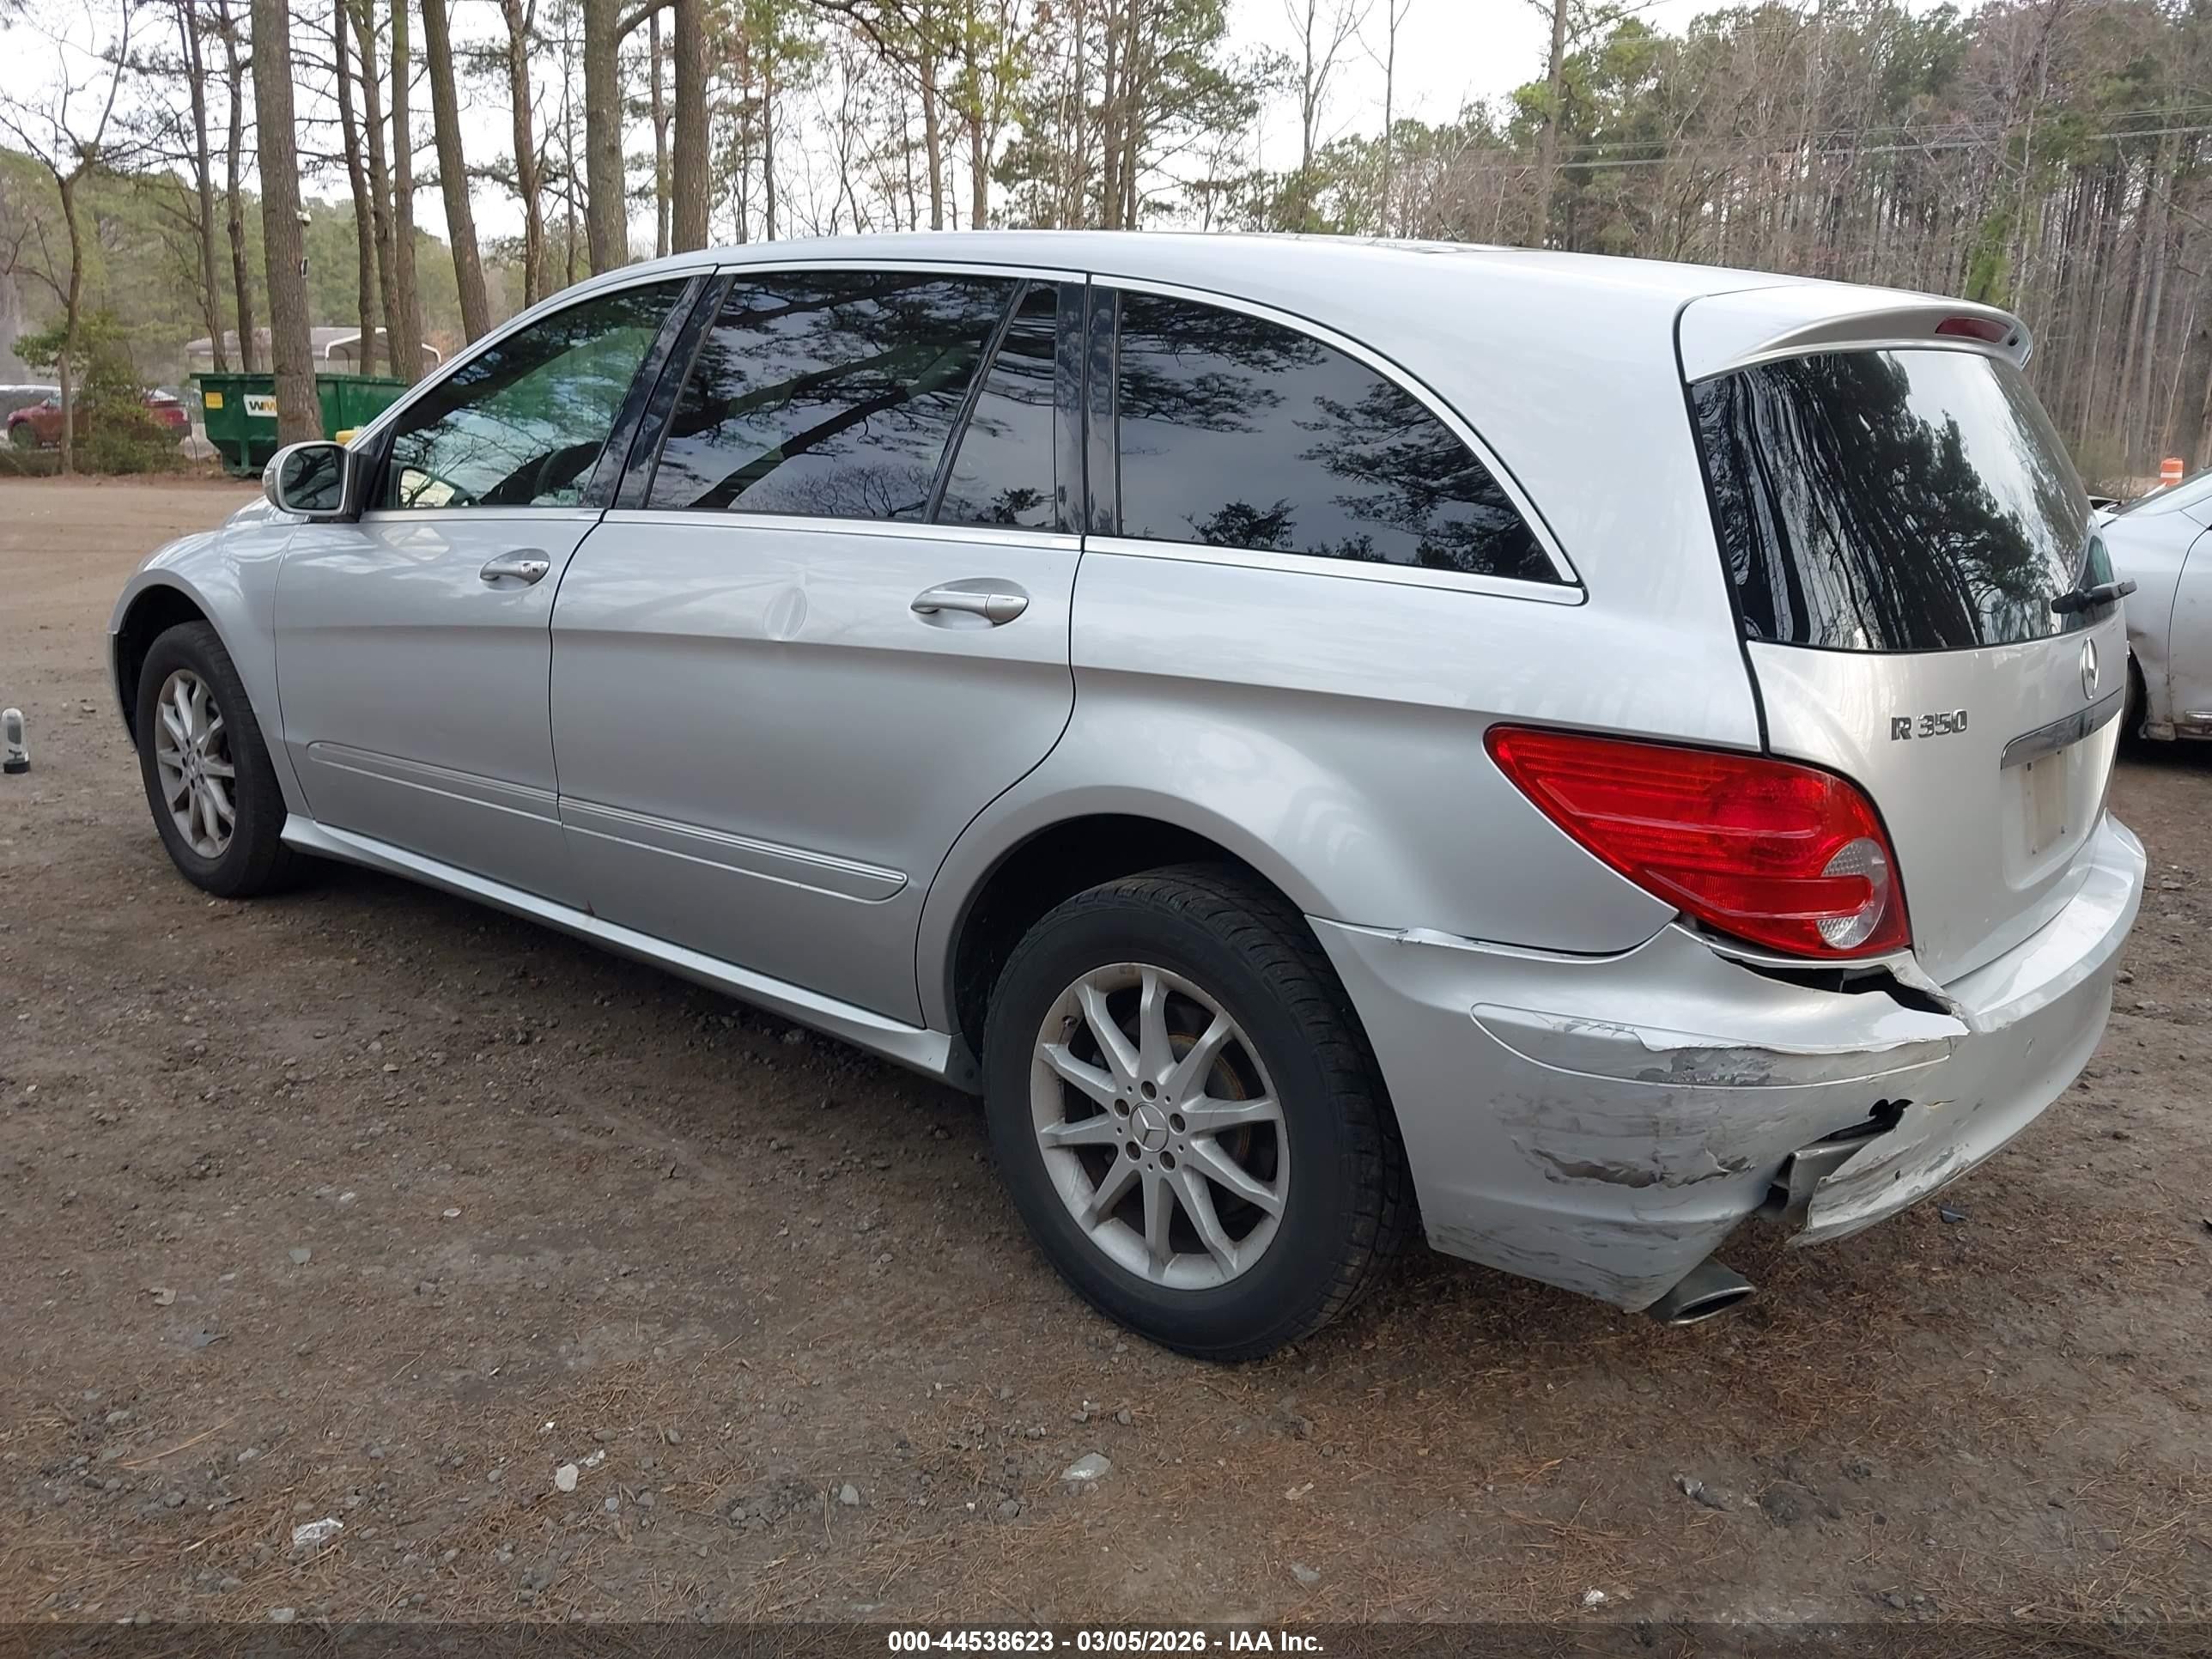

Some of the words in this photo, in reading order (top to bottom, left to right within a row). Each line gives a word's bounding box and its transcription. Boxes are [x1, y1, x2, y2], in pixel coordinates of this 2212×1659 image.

[249, 400, 276, 411] WM
[1891, 716, 1912, 741] R
[1916, 708, 1968, 738] 350
